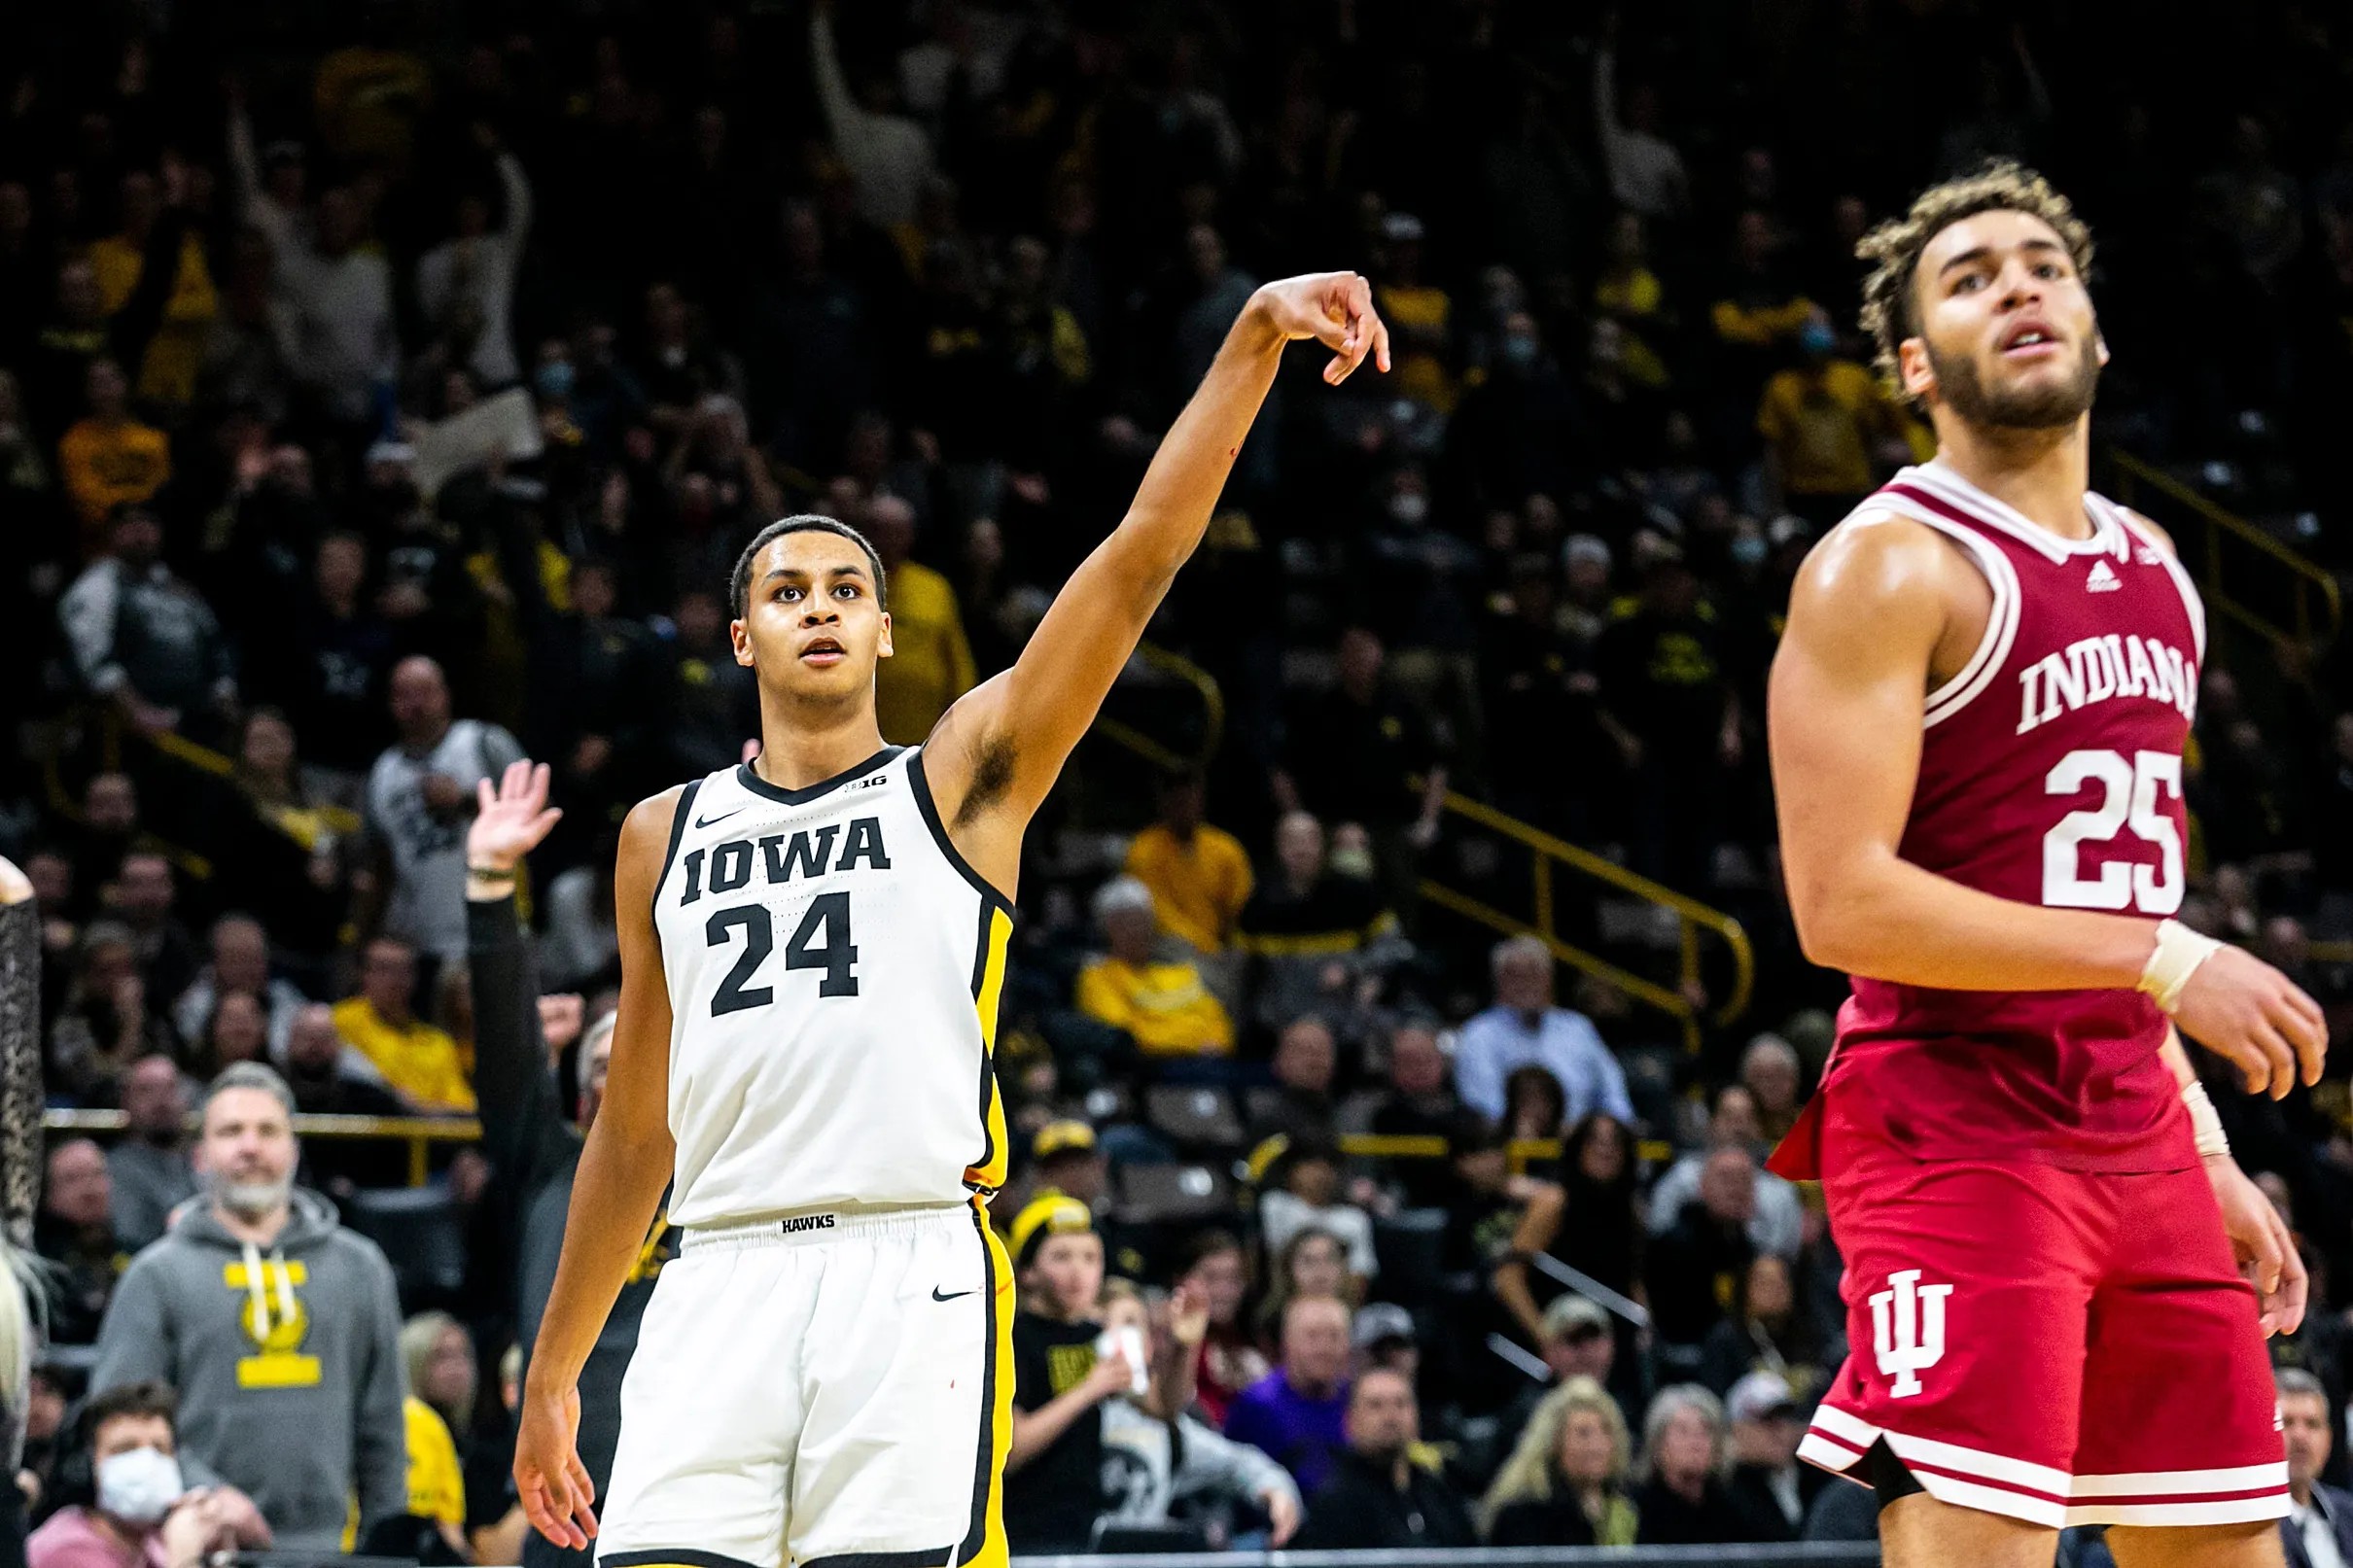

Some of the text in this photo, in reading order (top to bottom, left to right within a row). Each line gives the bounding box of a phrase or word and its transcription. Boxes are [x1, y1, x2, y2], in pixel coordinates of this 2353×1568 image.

[681, 817, 891, 908] IOWA
[2043, 749, 2184, 915] 25
[705, 891, 860, 1018] 24
[782, 1214, 835, 1234] HAWKS
